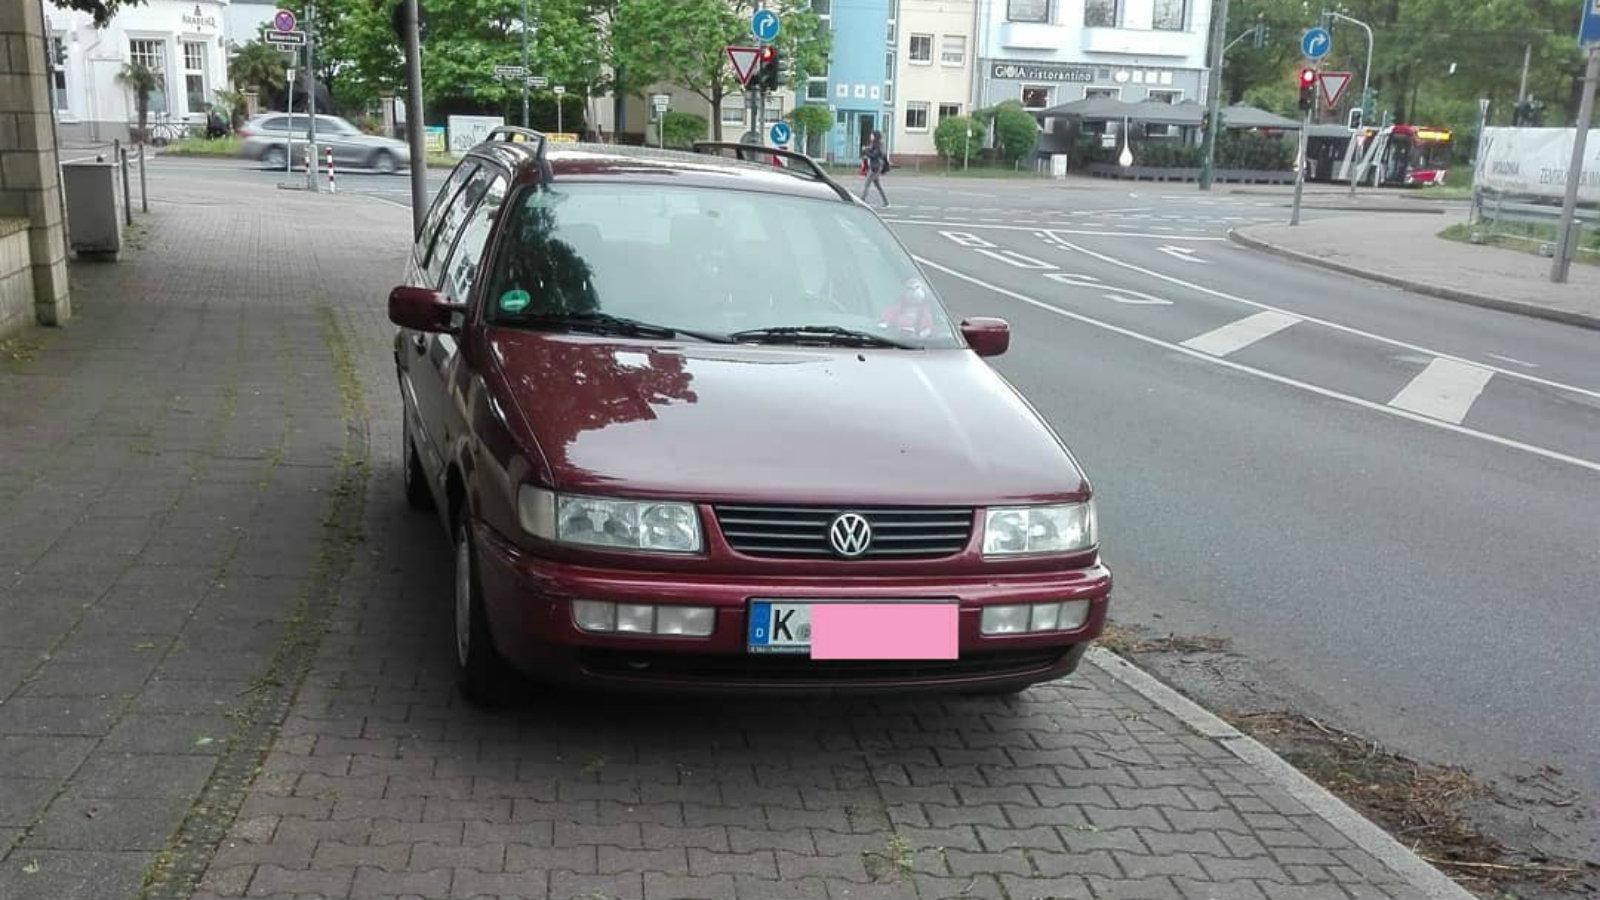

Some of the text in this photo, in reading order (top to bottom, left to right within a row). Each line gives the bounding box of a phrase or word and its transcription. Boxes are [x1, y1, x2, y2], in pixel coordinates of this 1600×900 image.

[1029, 67, 1091, 81] ristorantino
[939, 231, 1174, 304] BUS
[832, 514, 870, 555] VW
[773, 609, 796, 641] K
